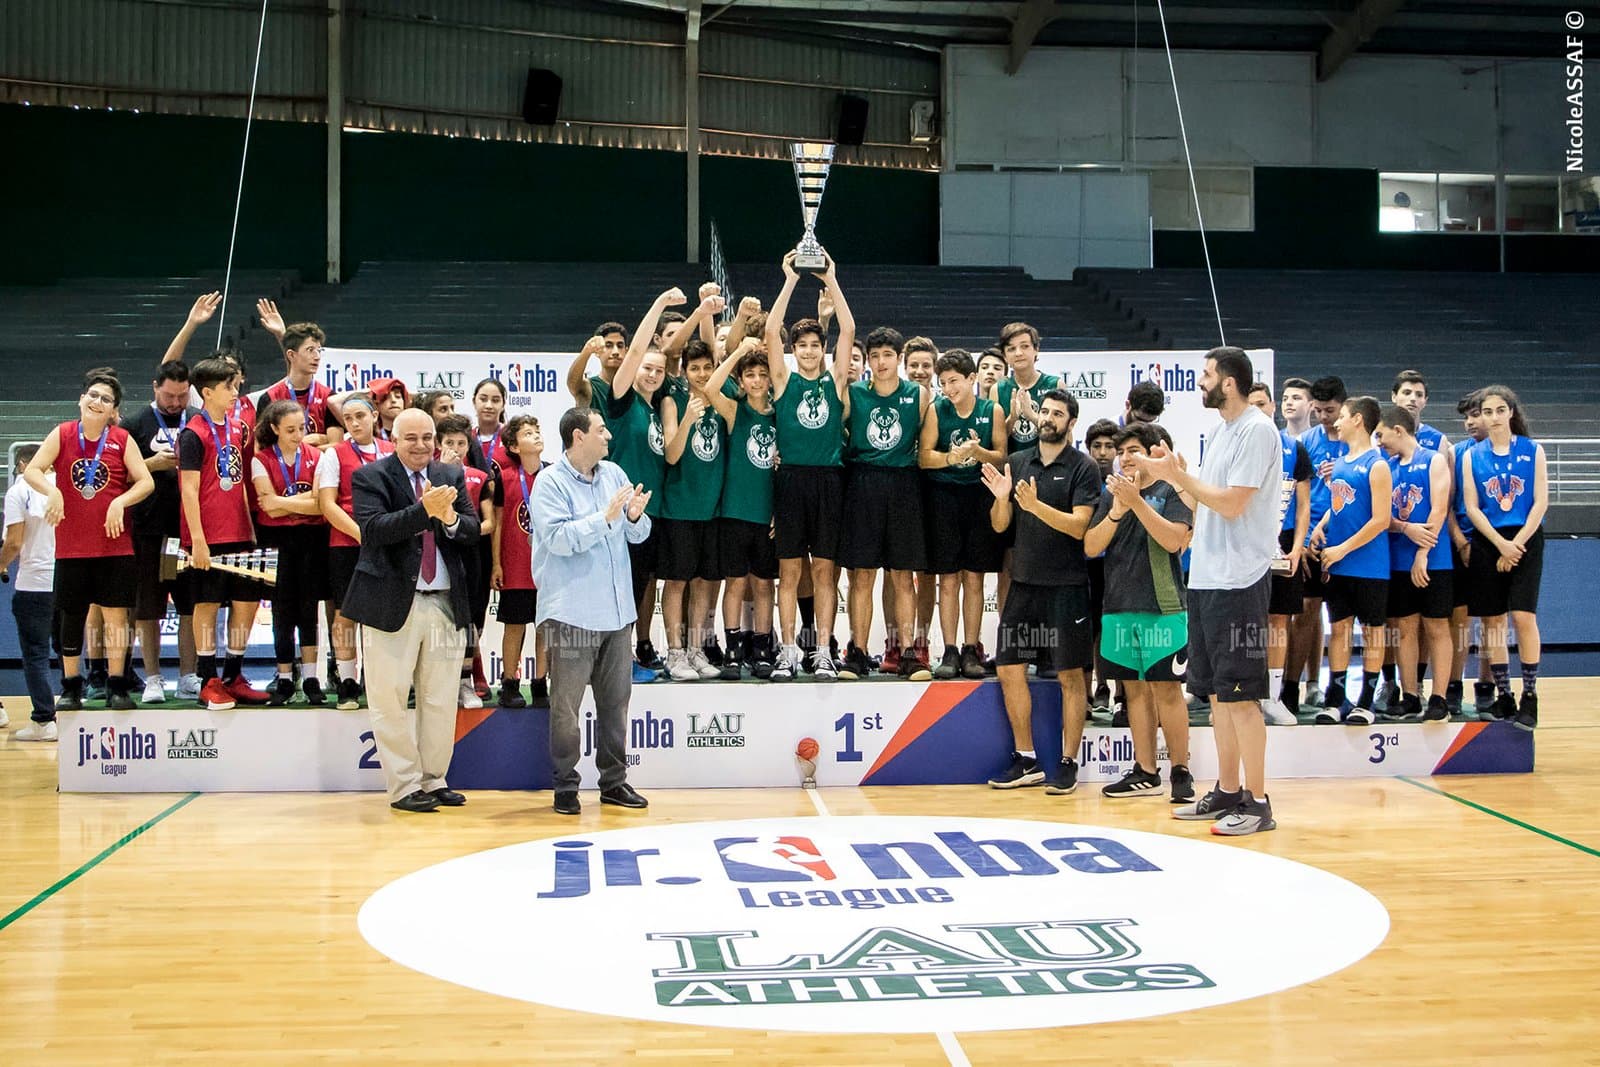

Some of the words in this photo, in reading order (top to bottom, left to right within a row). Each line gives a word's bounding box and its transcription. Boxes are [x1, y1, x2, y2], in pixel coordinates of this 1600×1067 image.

[416, 371, 464, 389] LAU
[524, 363, 557, 392] nba
[1061, 371, 1107, 389] LAU
[1164, 363, 1196, 392] nba
[508, 394, 532, 407] League
[631, 711, 674, 749] nba
[687, 713, 745, 735] LAU
[78, 727, 98, 767] jr.
[119, 727, 156, 760] nba
[167, 729, 218, 748] LAU
[687, 737, 745, 747] ATHLETICS
[168, 749, 218, 759] ATHLETICS
[1081, 736, 1097, 767] jr.
[1113, 735, 1136, 762] nb
[101, 763, 127, 777] League
[1098, 763, 1120, 776] League
[537, 840, 702, 899] jr.
[854, 831, 1164, 879] nba
[736, 883, 955, 910] League
[646, 917, 1144, 977] LAU
[667, 964, 1205, 1006] ATHLETICS
